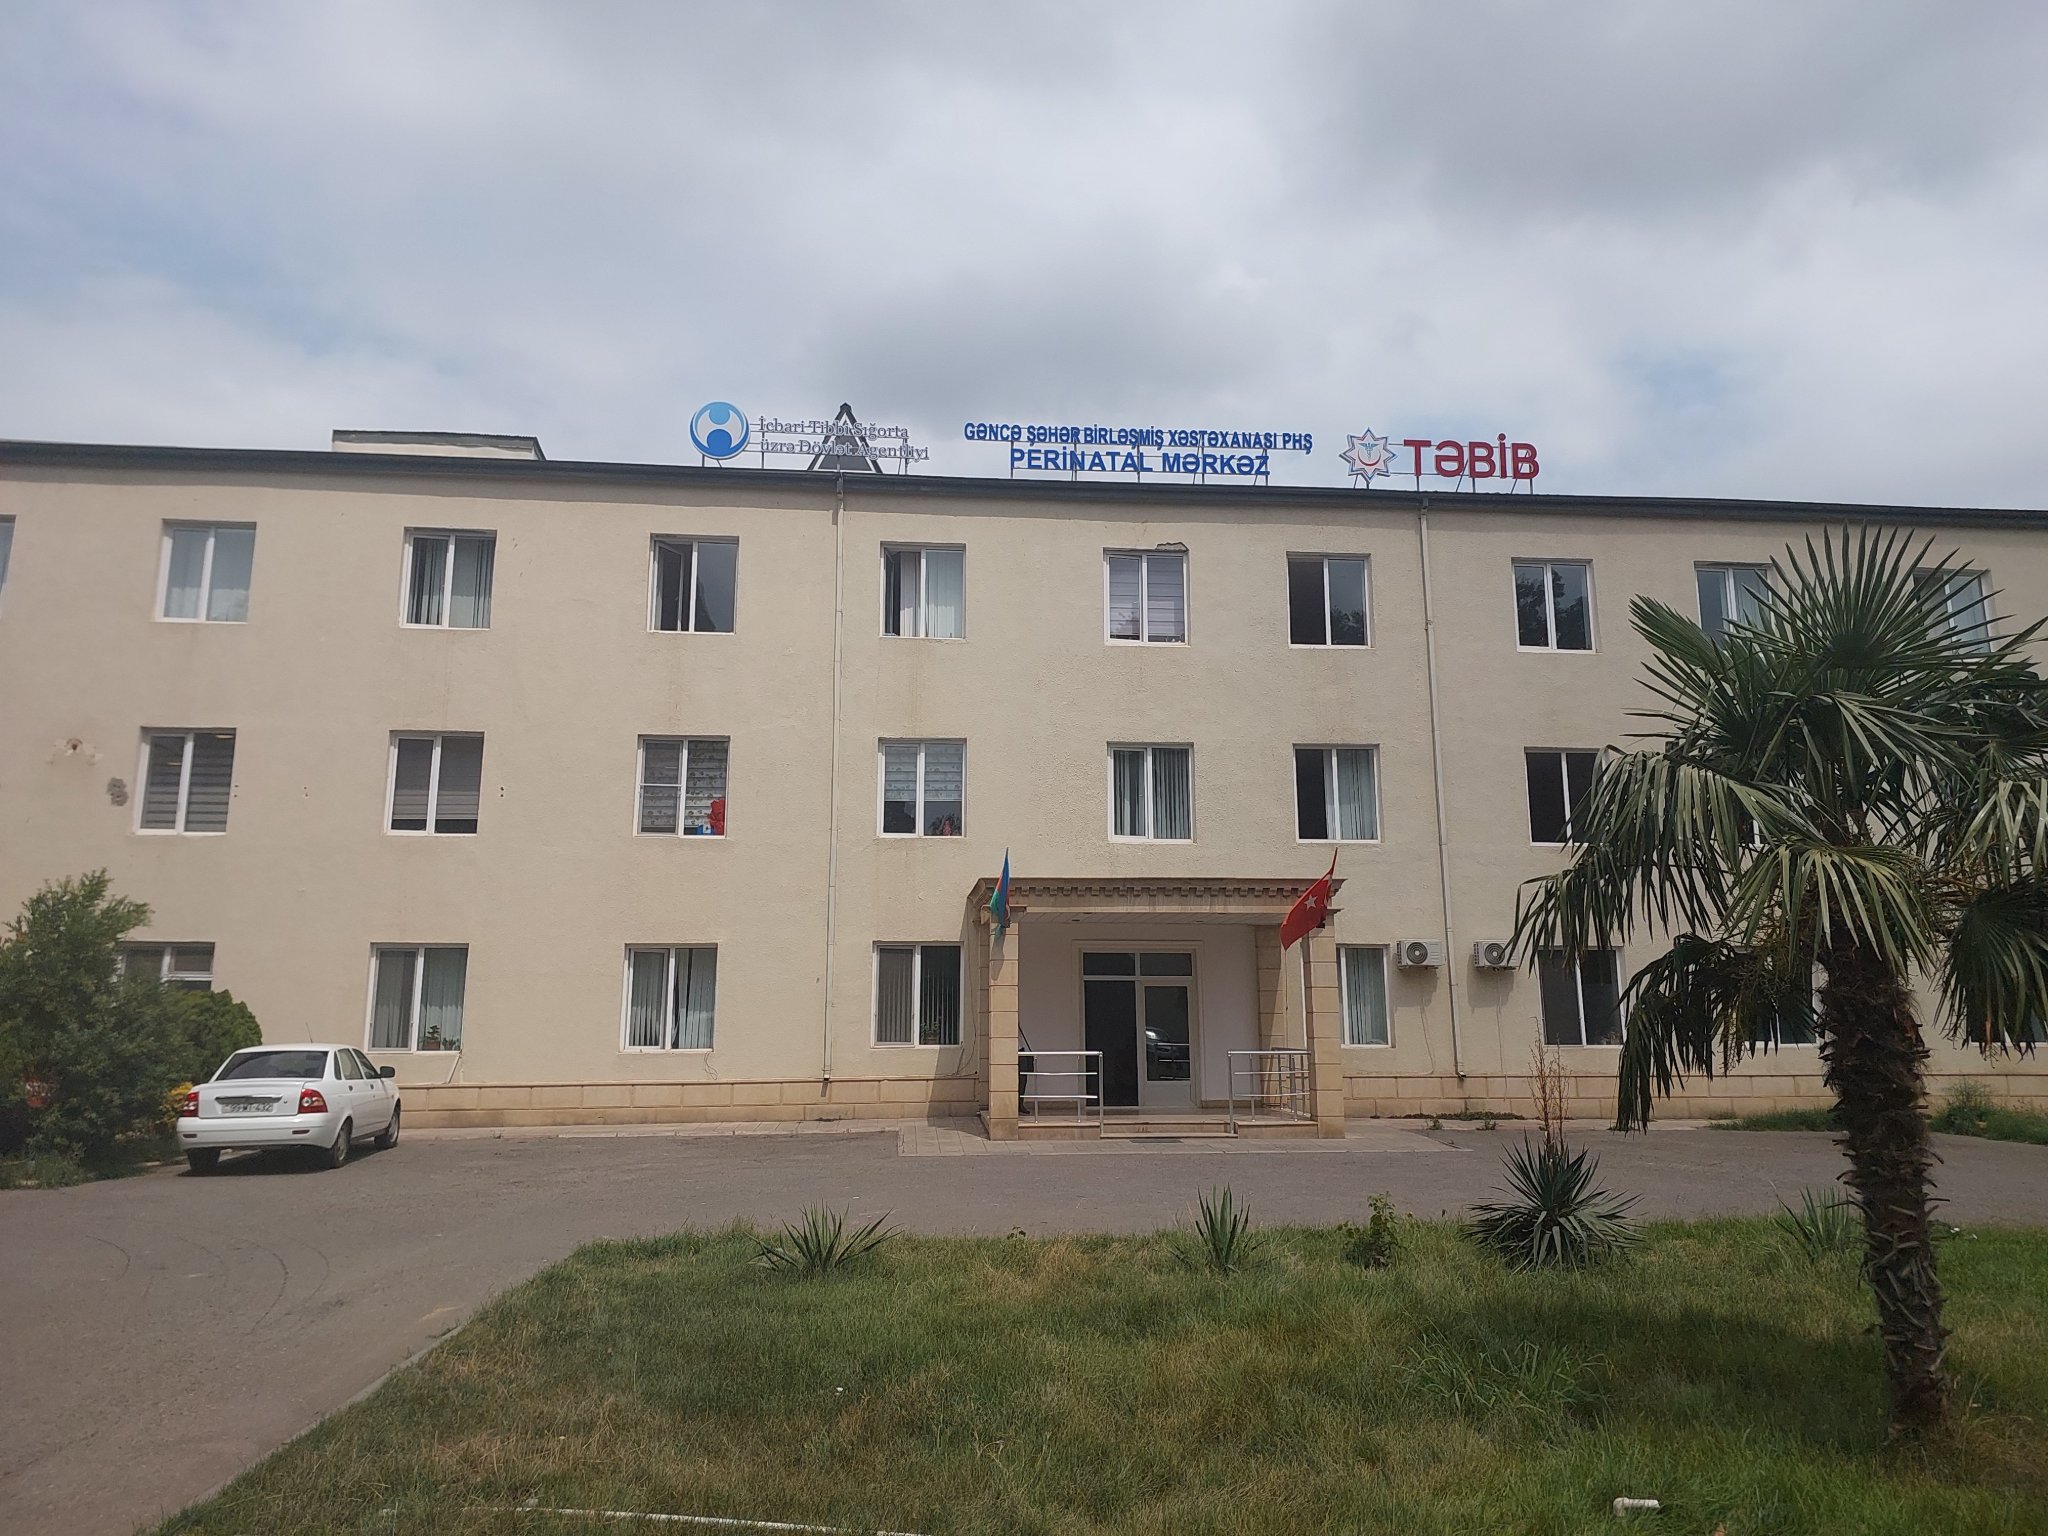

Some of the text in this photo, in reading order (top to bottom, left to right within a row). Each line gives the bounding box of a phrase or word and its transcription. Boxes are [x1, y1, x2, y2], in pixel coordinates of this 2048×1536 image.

[759, 416, 805, 433] İcbari
[854, 423, 909, 441] Sığorta
[964, 423, 1313, 455] GƏNCƏ ŞƏHƏR BİRLƏŞMİŞ XƏSTƏXANASI PHŞ
[760, 438, 795, 452] üzrə
[1403, 433, 1540, 479] TƏBİB
[1011, 446, 1271, 476] PERİNATAL MƏRKƏZ
